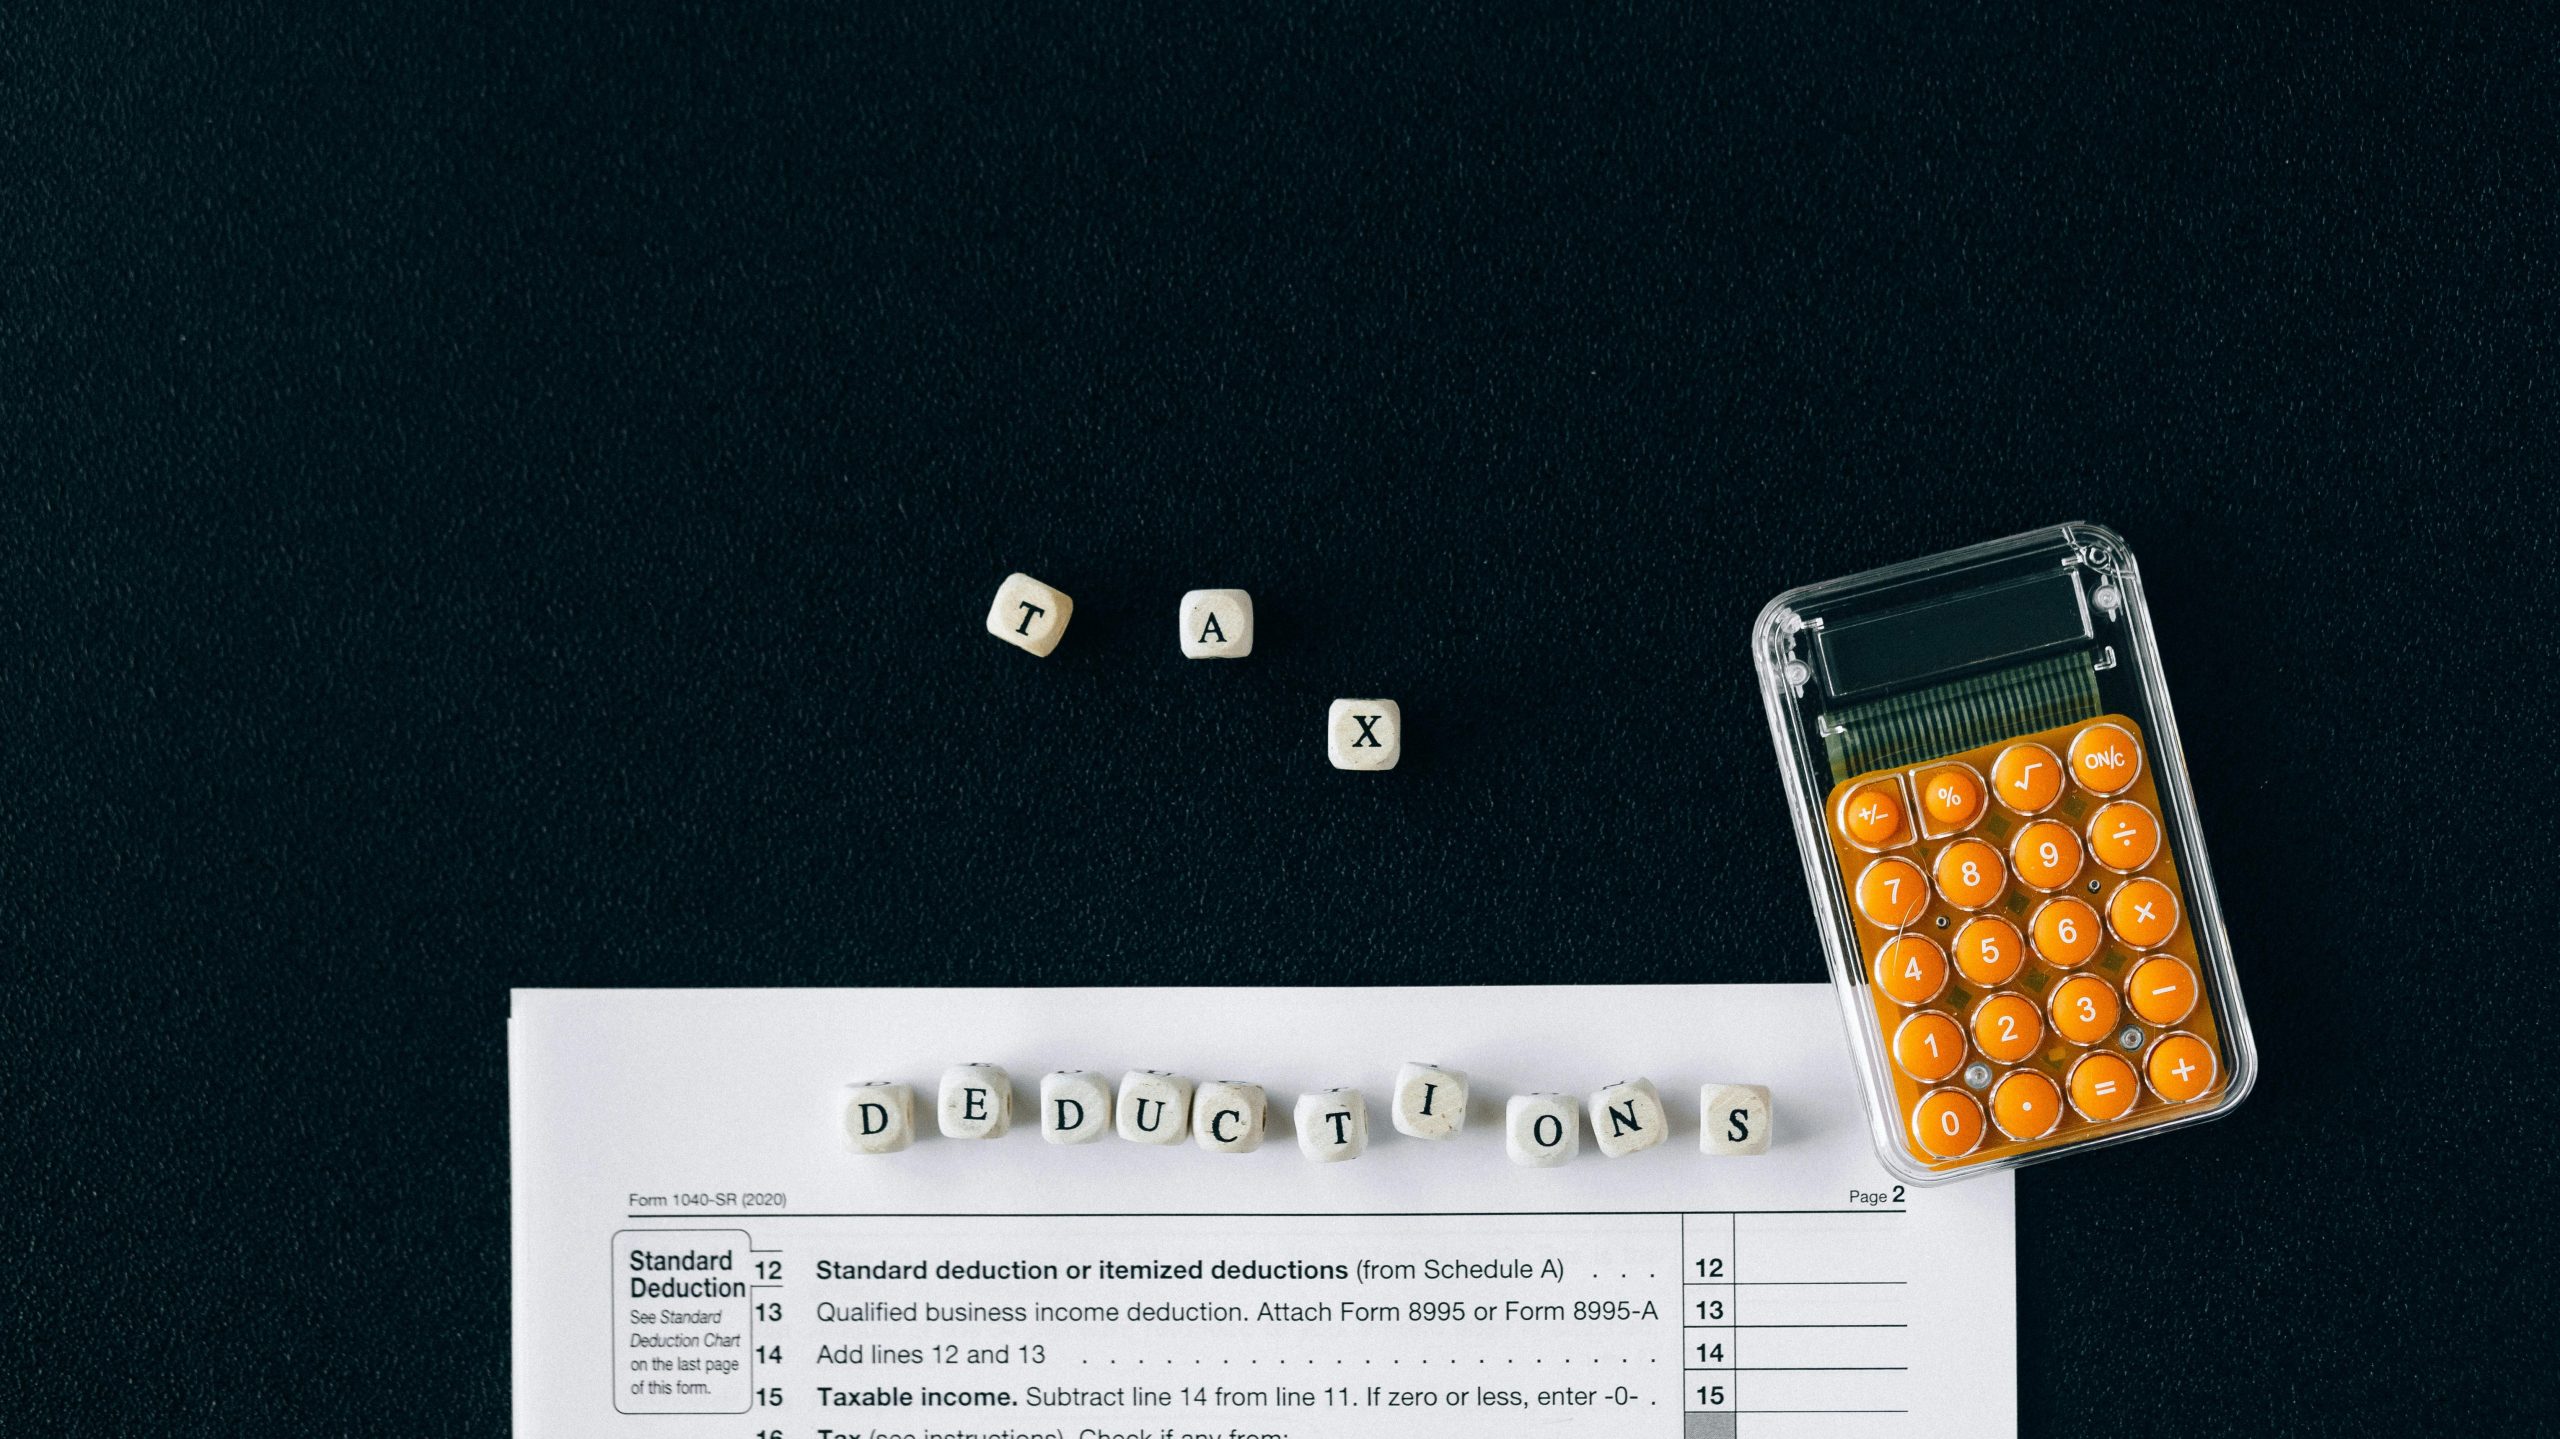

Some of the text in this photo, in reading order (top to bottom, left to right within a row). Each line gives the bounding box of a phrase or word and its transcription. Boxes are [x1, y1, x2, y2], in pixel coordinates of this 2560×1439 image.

[2084, 746, 2126, 770] ON/C
[1883, 878, 1901, 904] 7
[1961, 861, 1981, 887] 8
[2039, 842, 2059, 868] 9
[1904, 956, 1922, 981] 4
[1981, 937, 2000, 964] 5
[2058, 918, 2077, 944] 6
[1923, 1033, 1939, 1058] 1
[1997, 1015, 2018, 1042] 2
[2076, 996, 2096, 1022] 3
[1941, 1110, 1960, 1136] 0
[629, 1192, 787, 1208] Form 1040-SR (2020)
[1849, 1182, 1907, 1207] Page 2
[629, 1249, 733, 1271] Standard
[755, 1258, 1564, 1284] 12 Standard deduction or itemized deductions (from Schedule A)
[1696, 1258, 1724, 1278] 12
[630, 1276, 746, 1298] Deduction
[629, 1309, 723, 1325] See Standard
[755, 1300, 1659, 1323] 13 Qualified business income deduction. Attach Form 8995 or Form 8995-A
[1696, 1300, 1724, 1320] 13
[629, 1332, 742, 1348] Deduction Chart
[755, 1344, 1046, 1365] 14 Add lines 12 and 13
[1696, 1343, 1724, 1362] 14
[630, 1356, 740, 1375] on the last page
[630, 1379, 712, 1395] of this form.
[756, 1385, 1639, 1409] 15 Taxable income. Subtract line 14 from line 11. If zero or less, enter -0-
[1696, 1385, 1725, 1406] 15
